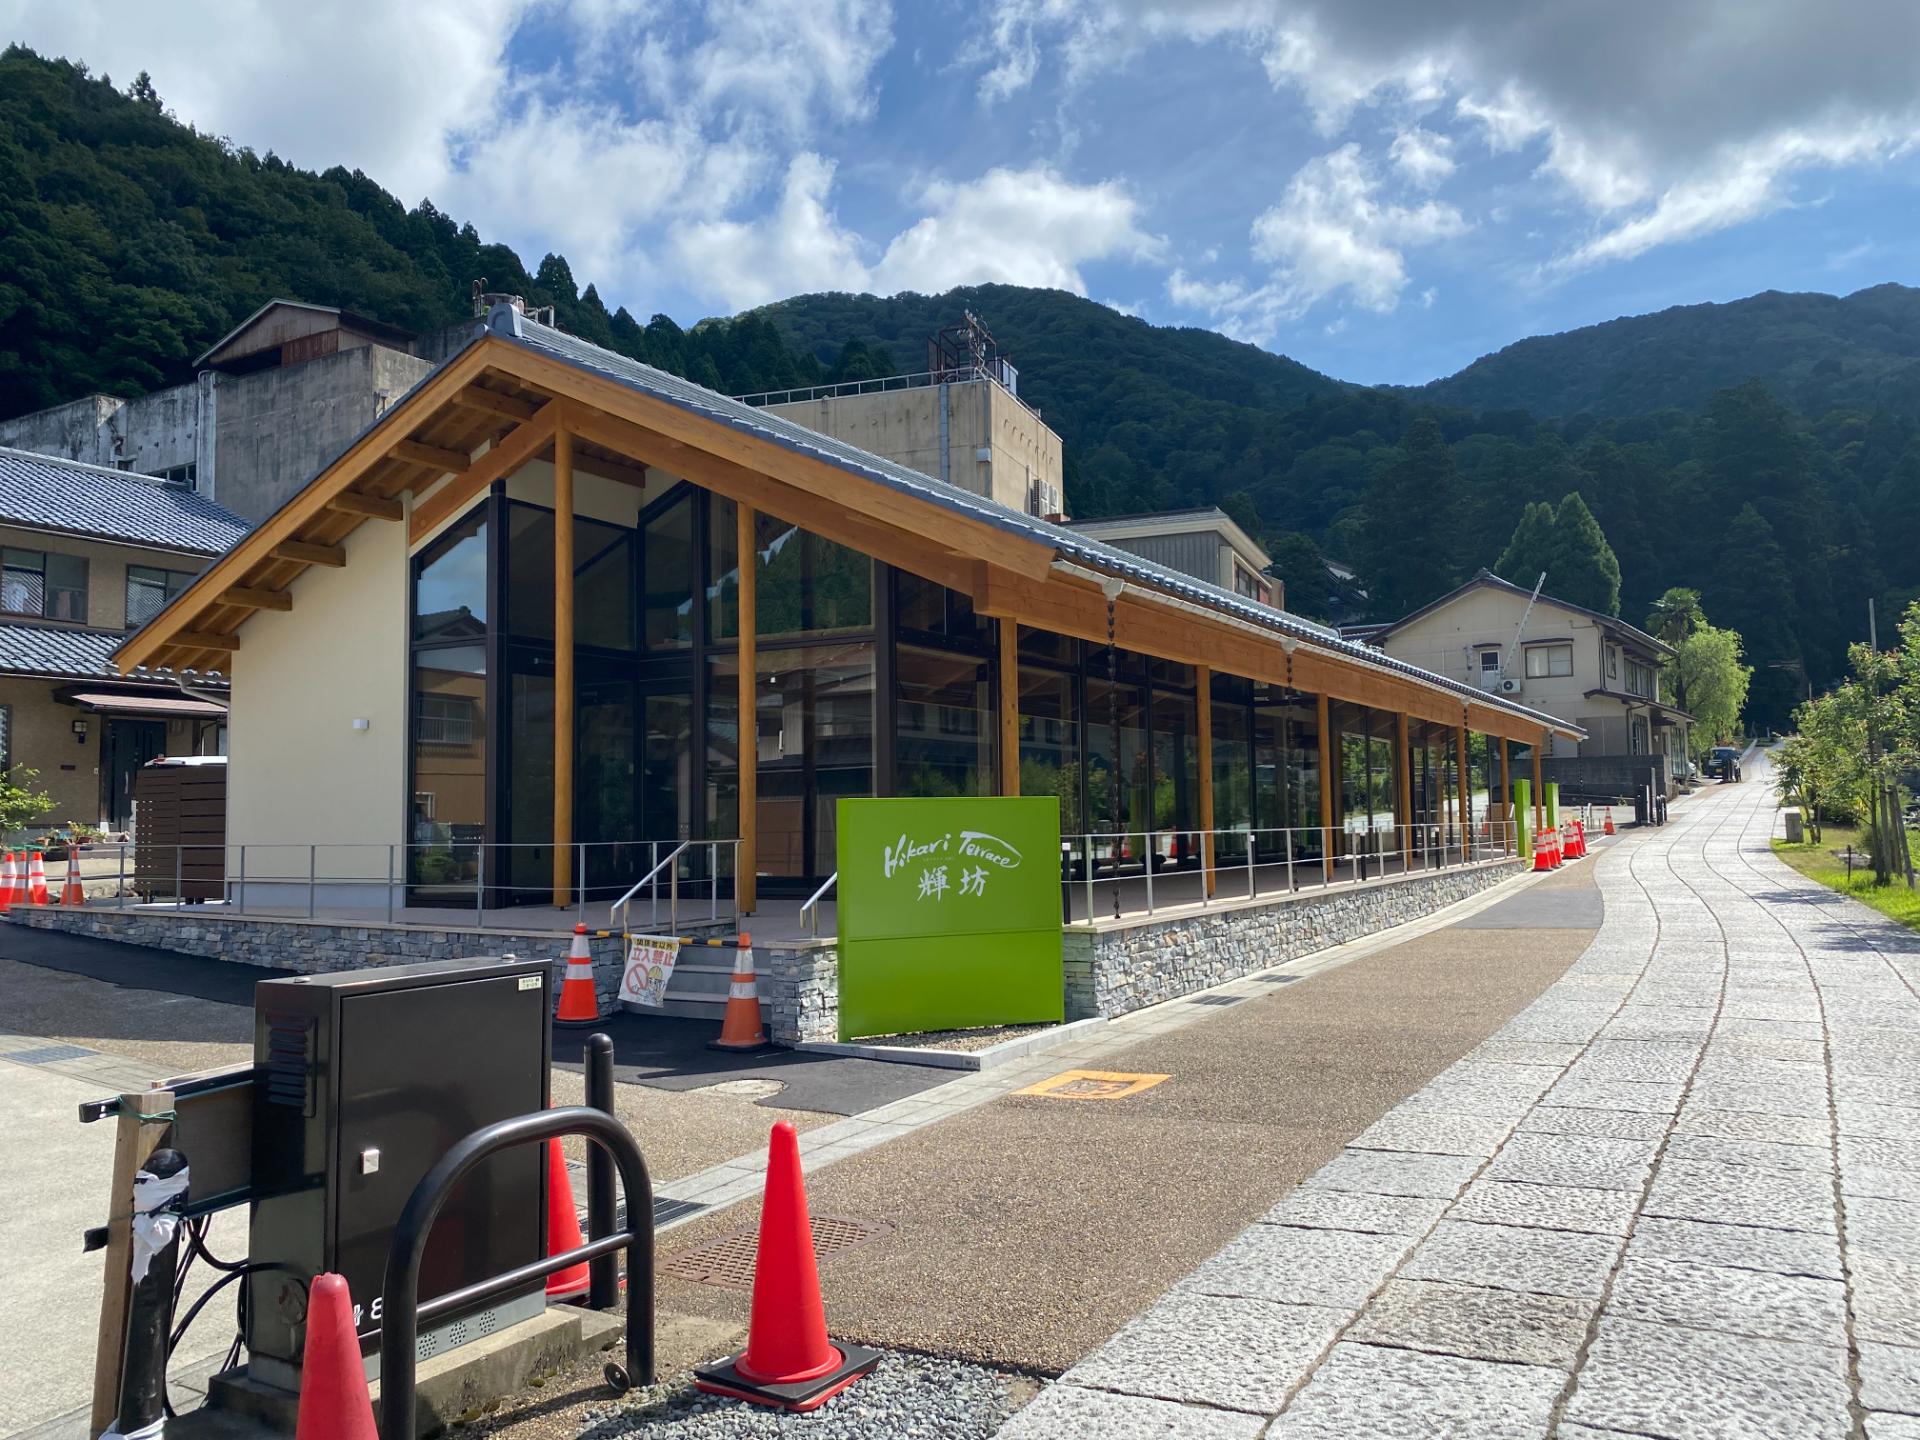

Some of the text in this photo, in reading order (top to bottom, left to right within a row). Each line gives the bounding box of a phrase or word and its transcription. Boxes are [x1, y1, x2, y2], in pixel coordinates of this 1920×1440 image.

[884, 831, 1023, 878] Hikari Terrace
[631, 946, 674, 968] 立入禁止
